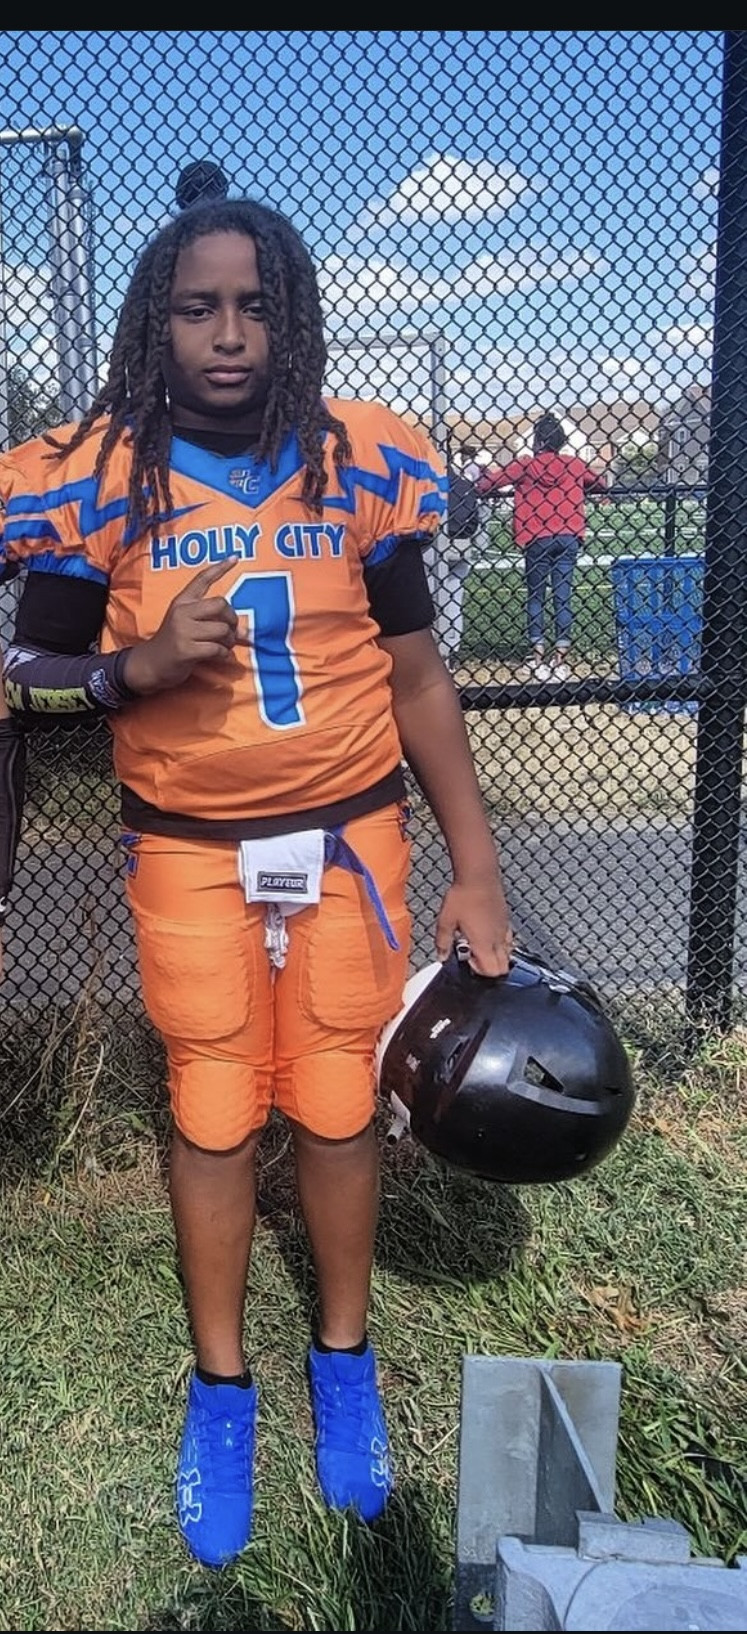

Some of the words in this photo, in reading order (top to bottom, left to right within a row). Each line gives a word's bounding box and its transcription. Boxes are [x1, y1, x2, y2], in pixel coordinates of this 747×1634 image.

[150, 523, 262, 571] HOLLY
[274, 522, 347, 558] CITY
[226, 570, 306, 731] 1
